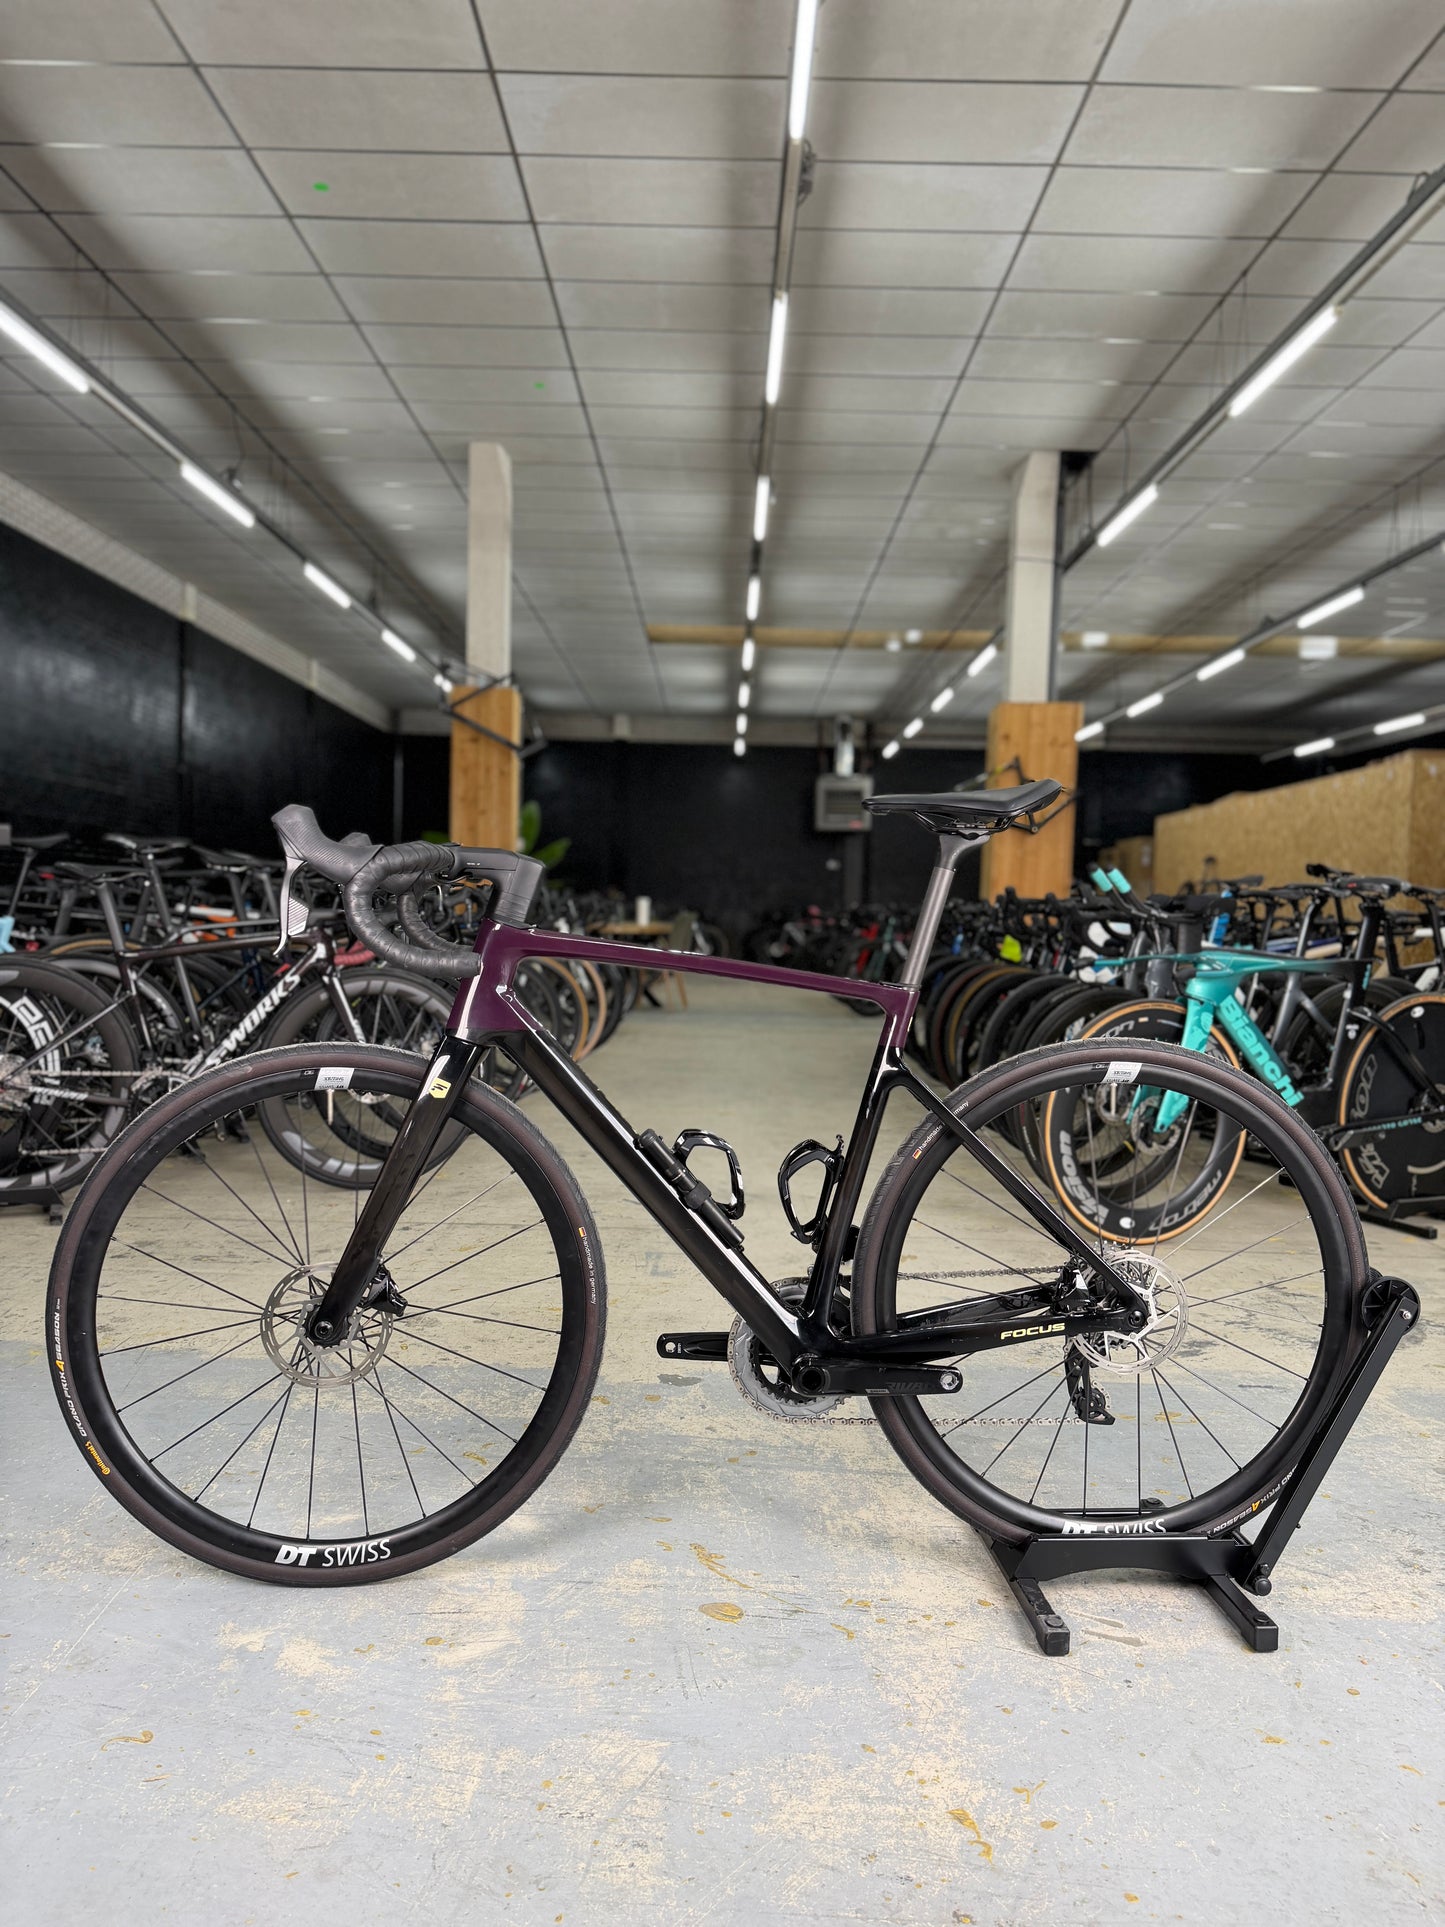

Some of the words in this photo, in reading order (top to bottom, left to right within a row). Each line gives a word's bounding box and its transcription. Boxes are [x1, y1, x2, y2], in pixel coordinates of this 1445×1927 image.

[204, 975, 301, 1068] S-WORKS
[1220, 994, 1304, 1107] Bianchi
[919, 1125, 943, 1151] handmade
[1351, 1053, 1390, 1189] Vion
[583, 1237, 594, 1269] handmade
[54, 1312, 63, 1360] SEASON
[1001, 1322, 1066, 1340] FOCUS
[67, 1401, 87, 1437] GRAND
[274, 1544, 317, 1567] DT
[322, 1538, 391, 1567] SWISS
